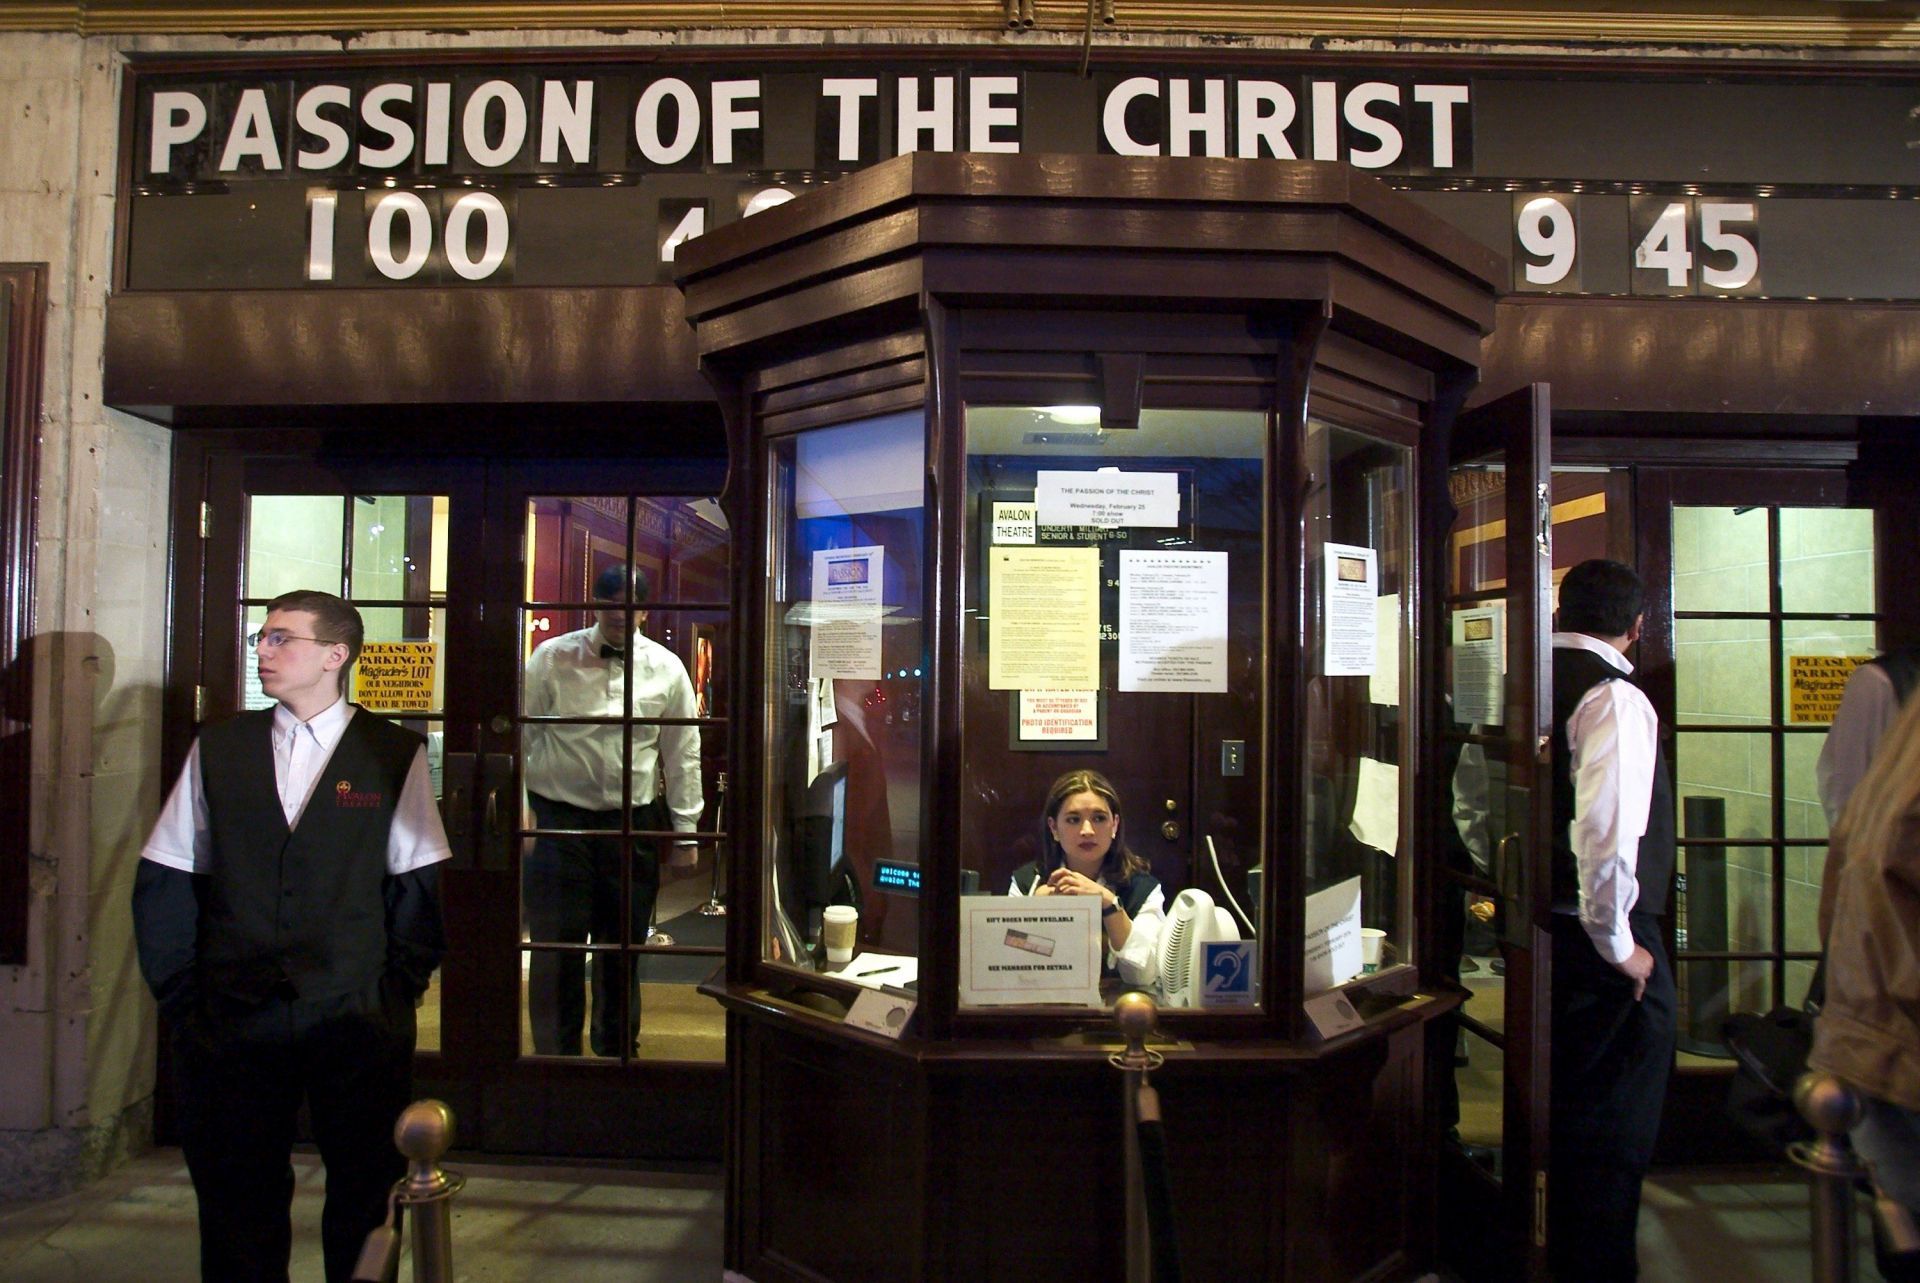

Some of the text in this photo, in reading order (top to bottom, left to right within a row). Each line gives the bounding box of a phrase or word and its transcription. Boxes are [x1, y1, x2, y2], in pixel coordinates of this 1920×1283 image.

[149, 76, 1469, 174] PASSION OF THE CHRIST
[1635, 203, 1759, 288] 45
[1060, 487, 1155, 496] THE PASSION OF THE CHRIST
[1108, 503, 1137, 511] February
[998, 509, 1031, 521] AVALON
[997, 526, 1034, 538] THEATRE
[1041, 532, 1069, 540] SENIOR
[1076, 532, 1107, 541] STUDENT
[363, 645, 433, 654] PLEASE NO
[359, 655, 434, 665] PARKING IN
[1796, 658, 1847, 667] PLEASE
[358, 664, 431, 680] Magruder's LOT
[365, 680, 424, 689] OUR NEIGHBORS
[380, 690, 403, 698] ALLOW
[406, 690, 414, 698] IT
[416, 690, 432, 698] AND
[375, 700, 388, 708] MAY
[391, 700, 399, 708] BE
[402, 700, 429, 709] TOWED
[1021, 718, 1093, 727] PHOTO IDENTIFICATION
[1041, 727, 1073, 735] REQUIRED
[881, 866, 910, 878] Welcome
[986, 916, 1001, 924] GIFT
[1033, 964, 1045, 972] FOR
[1046, 964, 1073, 972] DETAILS
